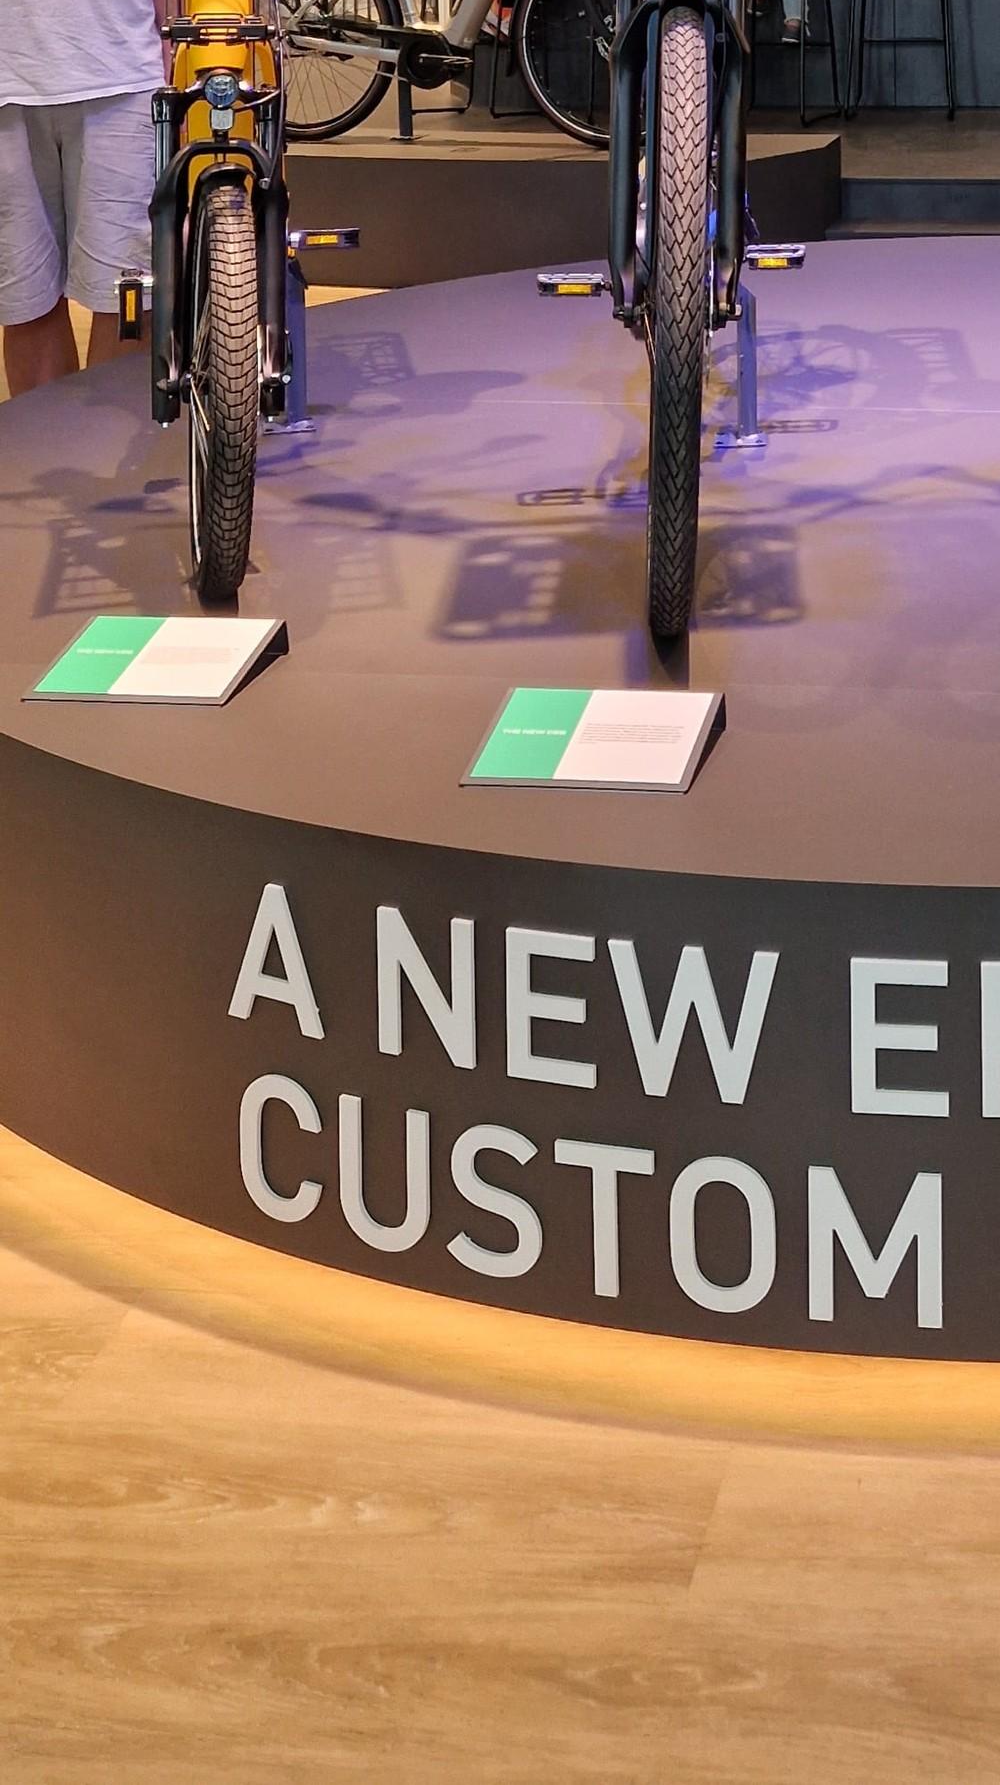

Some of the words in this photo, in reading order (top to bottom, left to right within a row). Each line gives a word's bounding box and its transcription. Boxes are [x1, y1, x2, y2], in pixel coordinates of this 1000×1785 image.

[227, 883, 325, 1040] A
[376, 906, 780, 1105] NEW
[239, 1073, 943, 1329] CUSTOM
